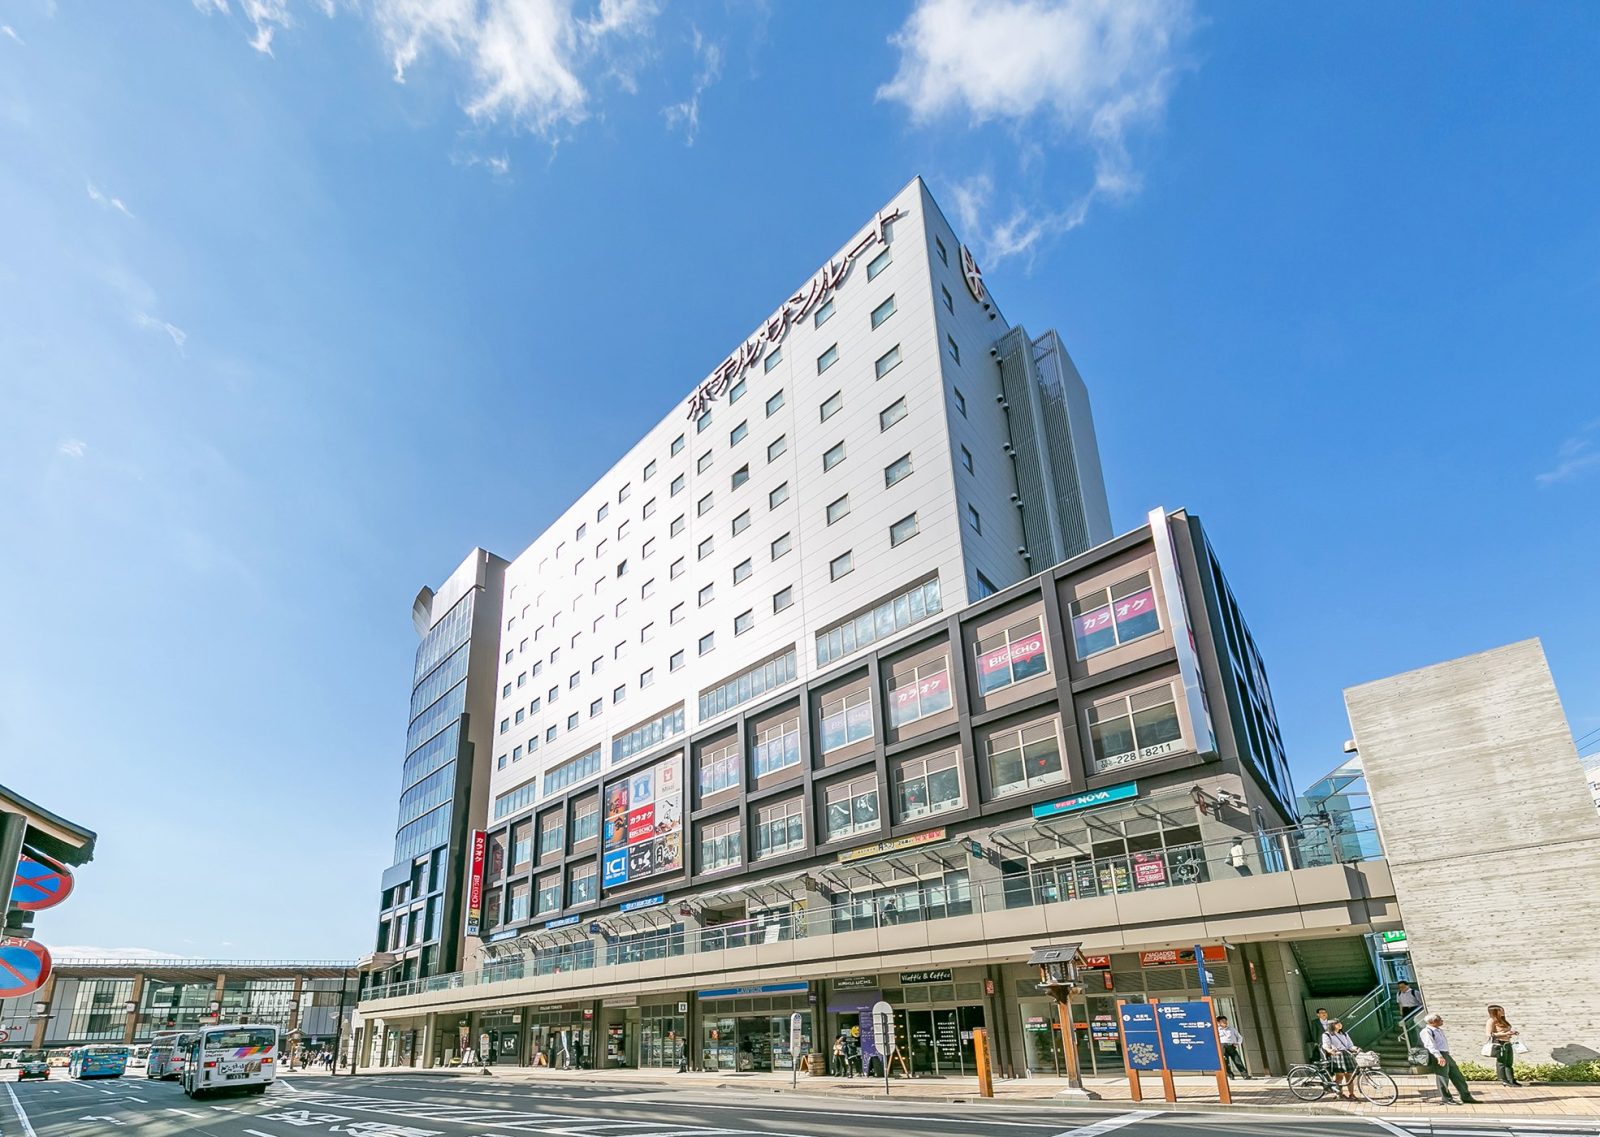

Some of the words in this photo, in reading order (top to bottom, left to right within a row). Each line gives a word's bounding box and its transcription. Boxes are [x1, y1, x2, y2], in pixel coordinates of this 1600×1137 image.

[1083, 597, 1148, 630] カラオケ
[898, 679, 941, 704] カラオケ
[1077, 791, 1110, 805] NOVA
[629, 811, 653, 825] カラオケ
[474, 837, 484, 862] カラオケ
[606, 857, 626, 876] ICI
[929, 969, 952, 979] Coffee
[737, 986, 763, 994] LAWSON
